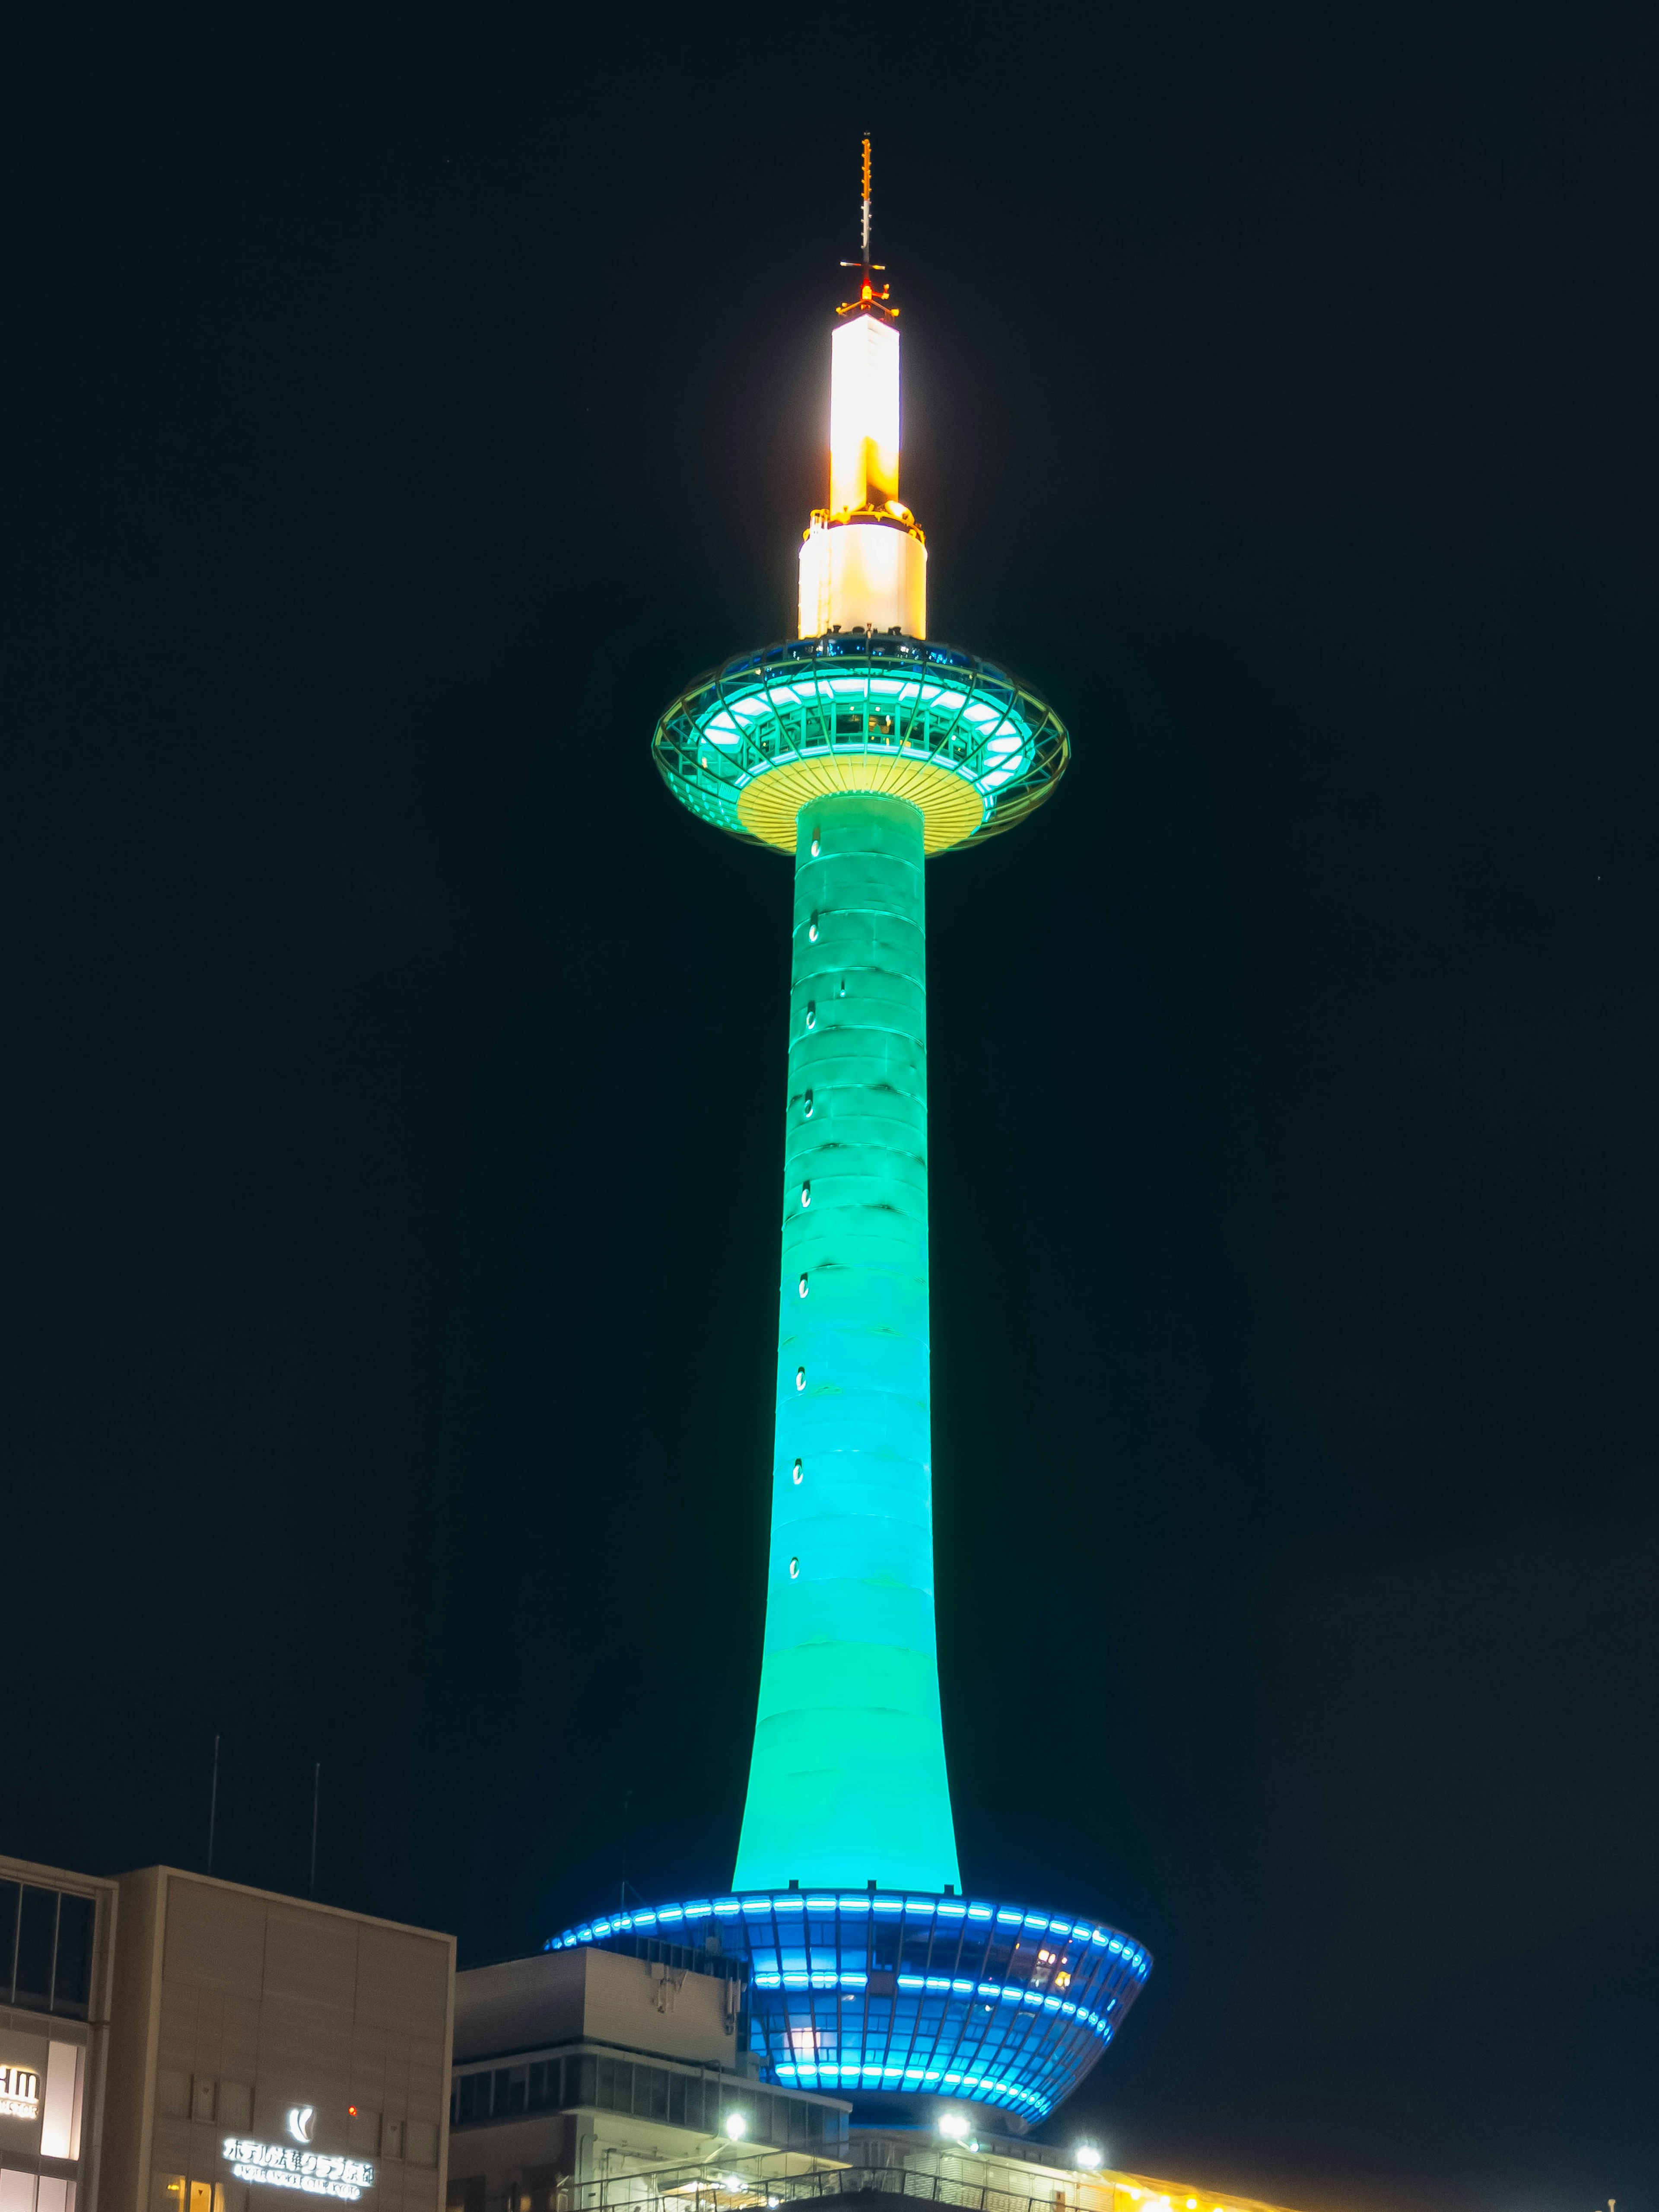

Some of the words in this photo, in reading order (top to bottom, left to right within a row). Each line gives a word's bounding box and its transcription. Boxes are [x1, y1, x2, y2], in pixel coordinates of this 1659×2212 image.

[226, 2139, 374, 2185] ホテル法華クラブ京都
